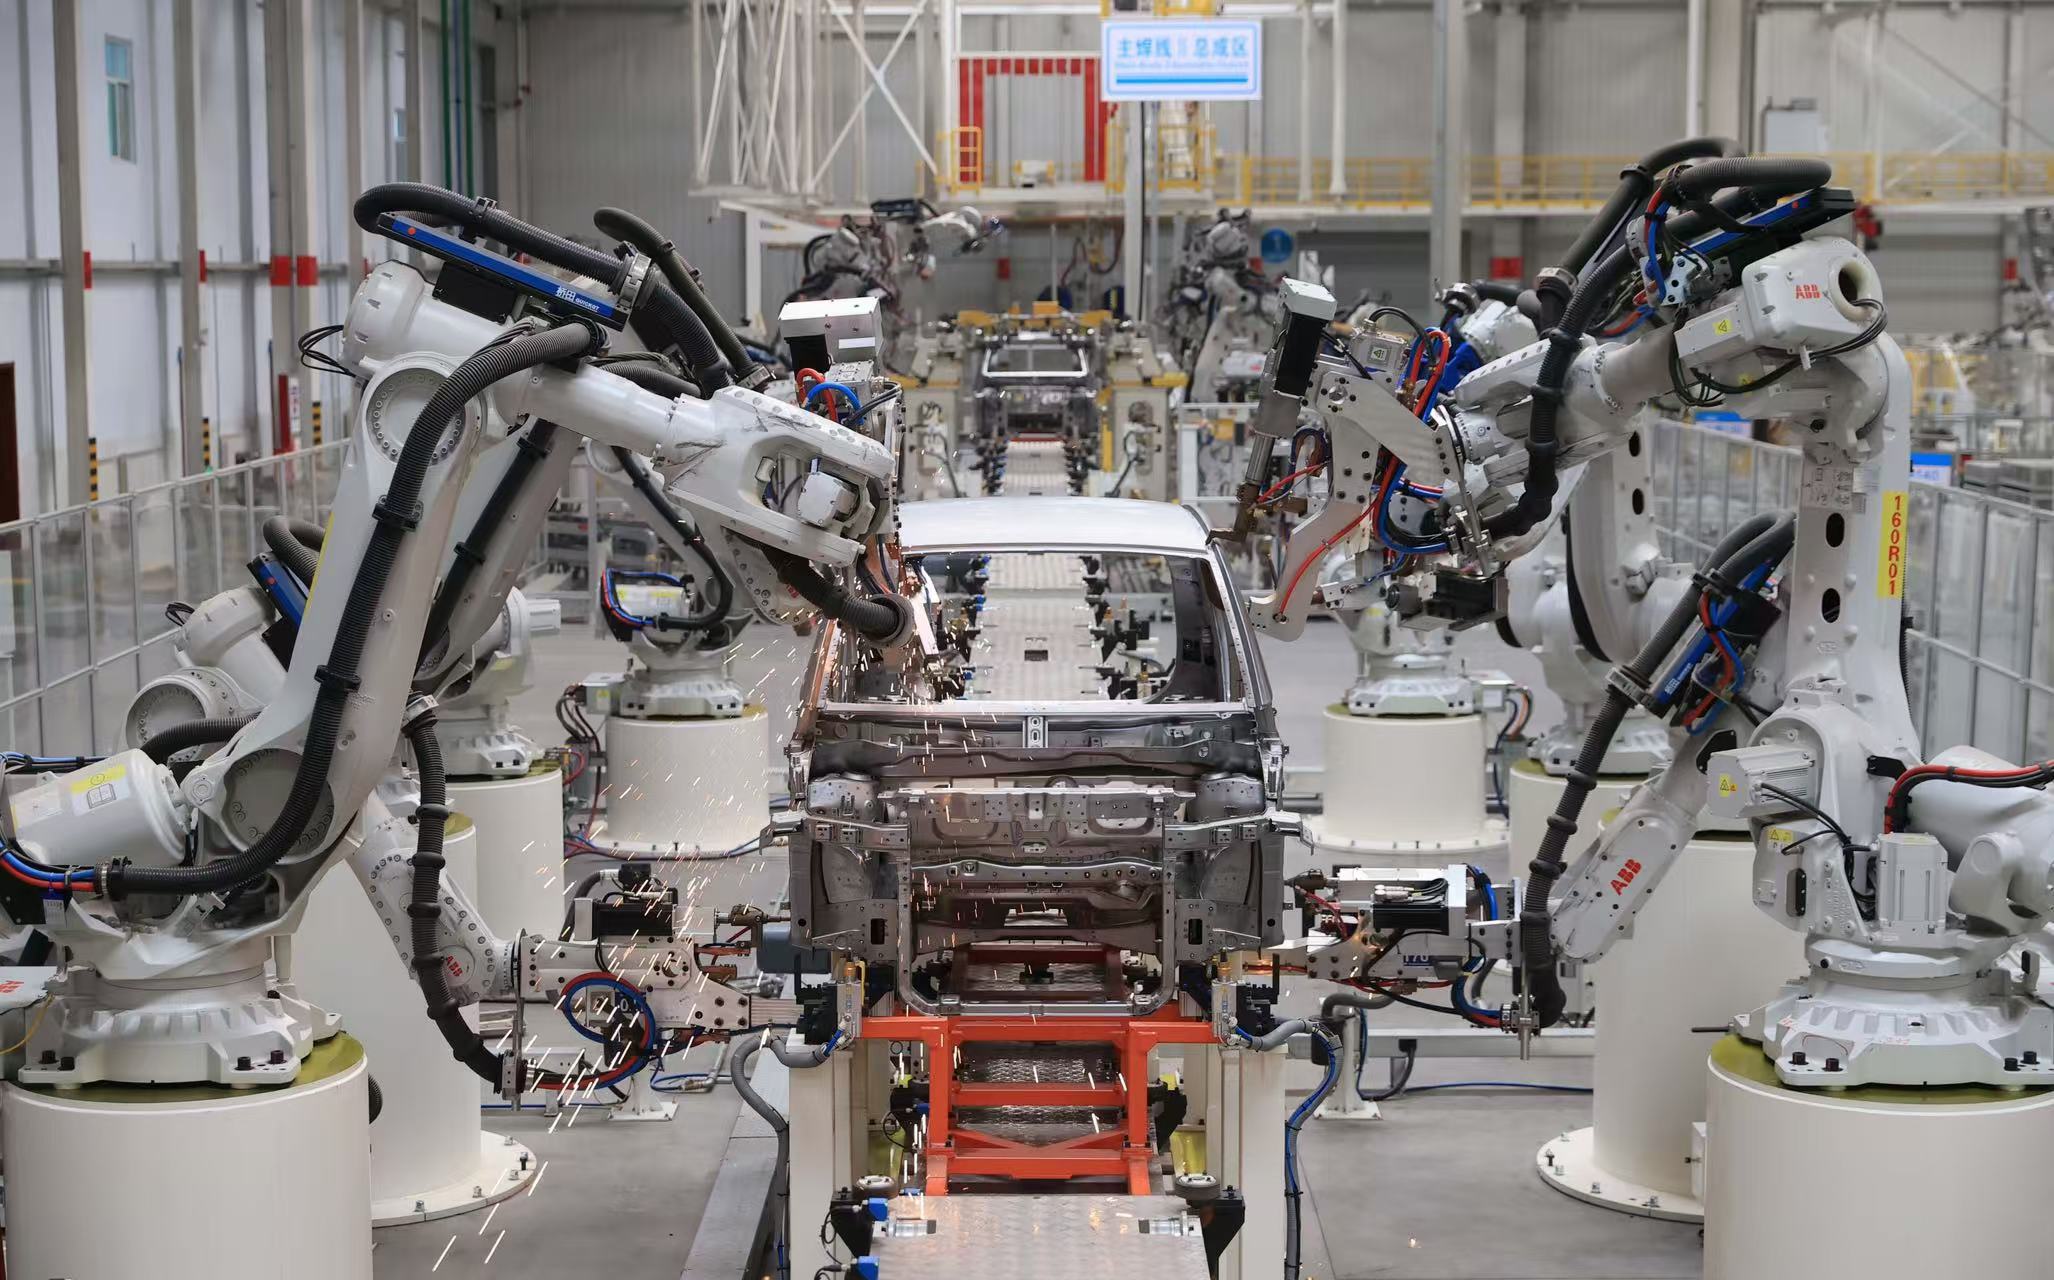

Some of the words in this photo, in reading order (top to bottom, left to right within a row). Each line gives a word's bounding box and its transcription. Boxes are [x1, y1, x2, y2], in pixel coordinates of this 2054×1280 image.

[1795, 284, 1821, 299] ABB
[1888, 495, 1901, 595] 160R01
[1610, 858, 1642, 896] ABB
[446, 955, 463, 977] ABB
